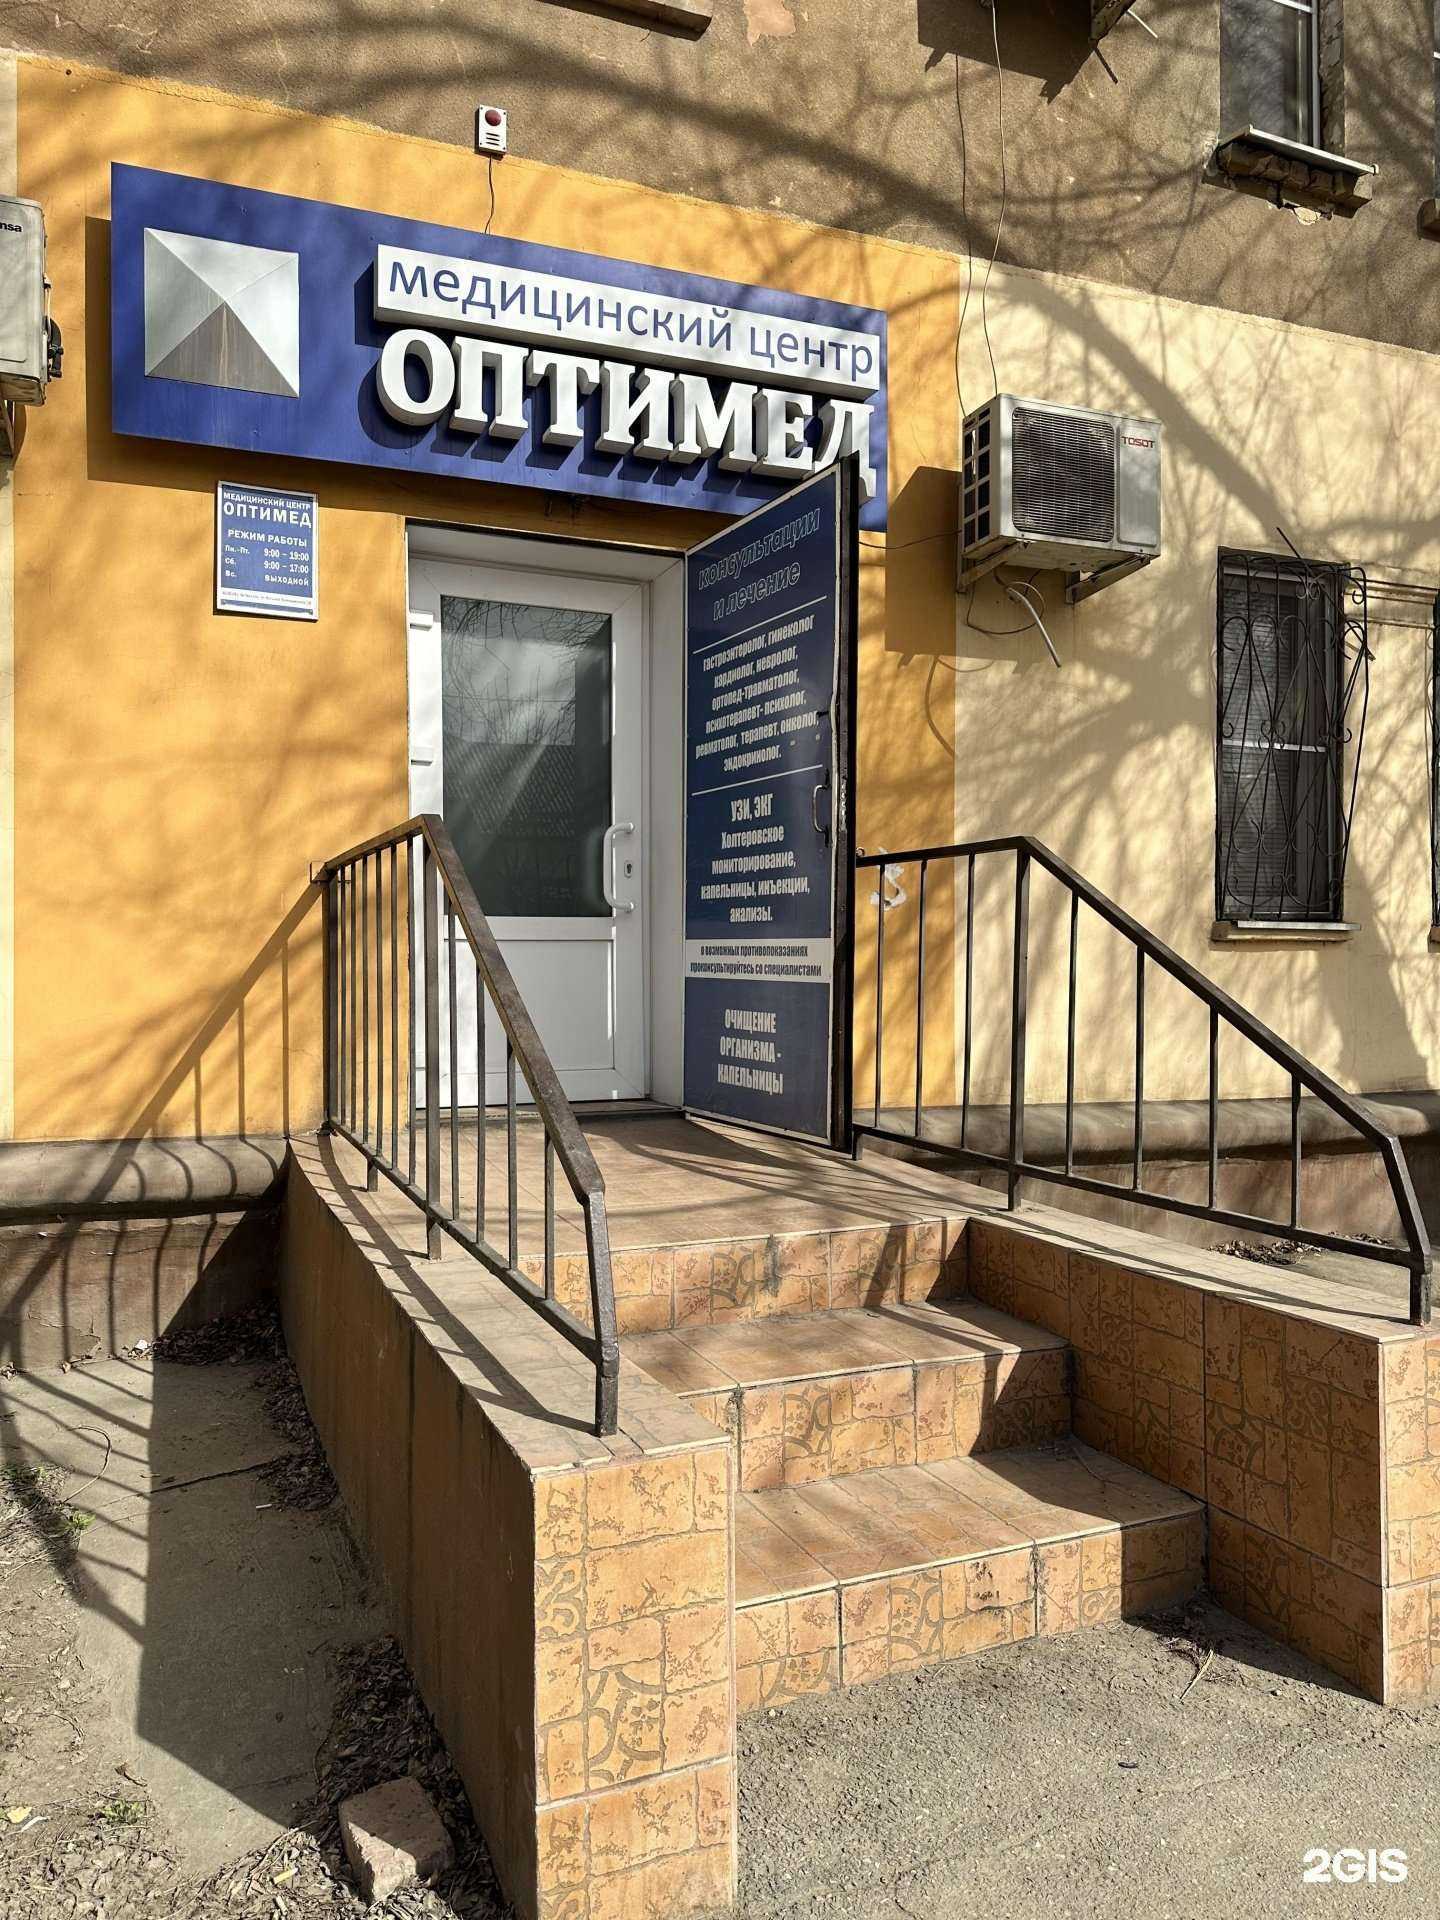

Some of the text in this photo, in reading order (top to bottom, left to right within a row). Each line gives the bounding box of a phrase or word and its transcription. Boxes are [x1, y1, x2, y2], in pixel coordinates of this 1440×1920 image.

[389, 260, 874, 381] медицинский центр
[377, 328, 876, 498] ОПТИМЕД
[1122, 436, 1155, 448] TOSOT
[223, 492, 311, 511] МЕДИЦИНСКИЙ ЦЕНТР
[223, 501, 312, 529] ОПТИМЕД
[227, 529, 307, 548] РЕЖИМ РАБОТЫ
[698, 508, 821, 590] консультации
[224, 557, 237, 565] Сб.
[263, 560, 280, 571] 9:00
[289, 563, 309, 574] 17:00
[263, 547, 280, 558] 9:00
[289, 551, 310, 562] 19:00
[225, 569, 237, 578] Вс.
[713, 562, 801, 621] и лечение
[768, 615, 815, 646] гинеколог
[714, 645, 798, 689] кардиолог, невролог,
[741, 722, 779, 745] терапевт,
[780, 710, 819, 734] онколог,
[731, 793, 774, 822] УЗИ, ЭКГ
[721, 825, 785, 850] Холтеровское
[711, 850, 797, 875] мониторирование,
[700, 876, 811, 900] капельницы, инъекции,
[730, 905, 773, 923] анализы.
[740, 945, 808, 957] противопоказаниях
[755, 965, 763, 975] со
[763, 964, 822, 977] специалистами
[724, 1008, 777, 1034] ОЧИЩЕНИЕ
[717, 1063, 784, 1095] КАПЕЛЬНИЦЫ
